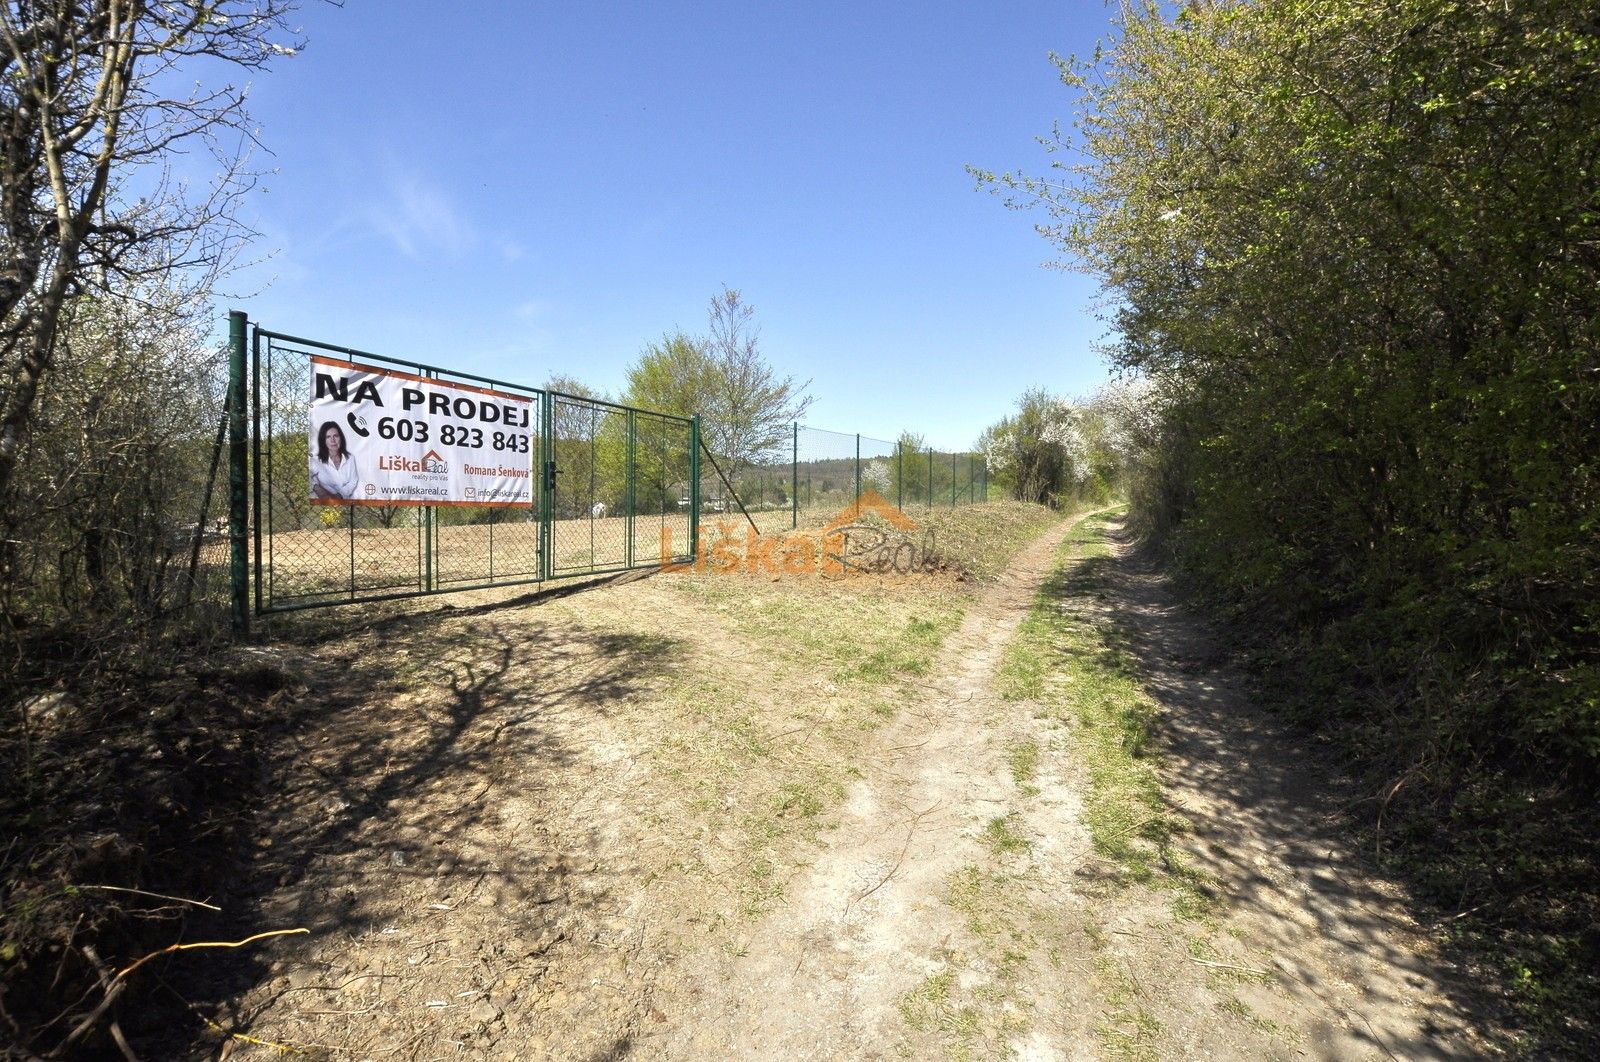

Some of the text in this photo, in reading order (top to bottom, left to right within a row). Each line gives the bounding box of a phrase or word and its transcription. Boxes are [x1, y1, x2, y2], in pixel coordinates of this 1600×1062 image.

[315, 373, 529, 428] NA PRODEJ
[378, 417, 529, 454] 603 823 843
[379, 456, 420, 472] Liška
[464, 464, 529, 479] Romana Šenková
[380, 486, 448, 495] www.liskareal.cz
[478, 488, 529, 498] info@liskareal.cz
